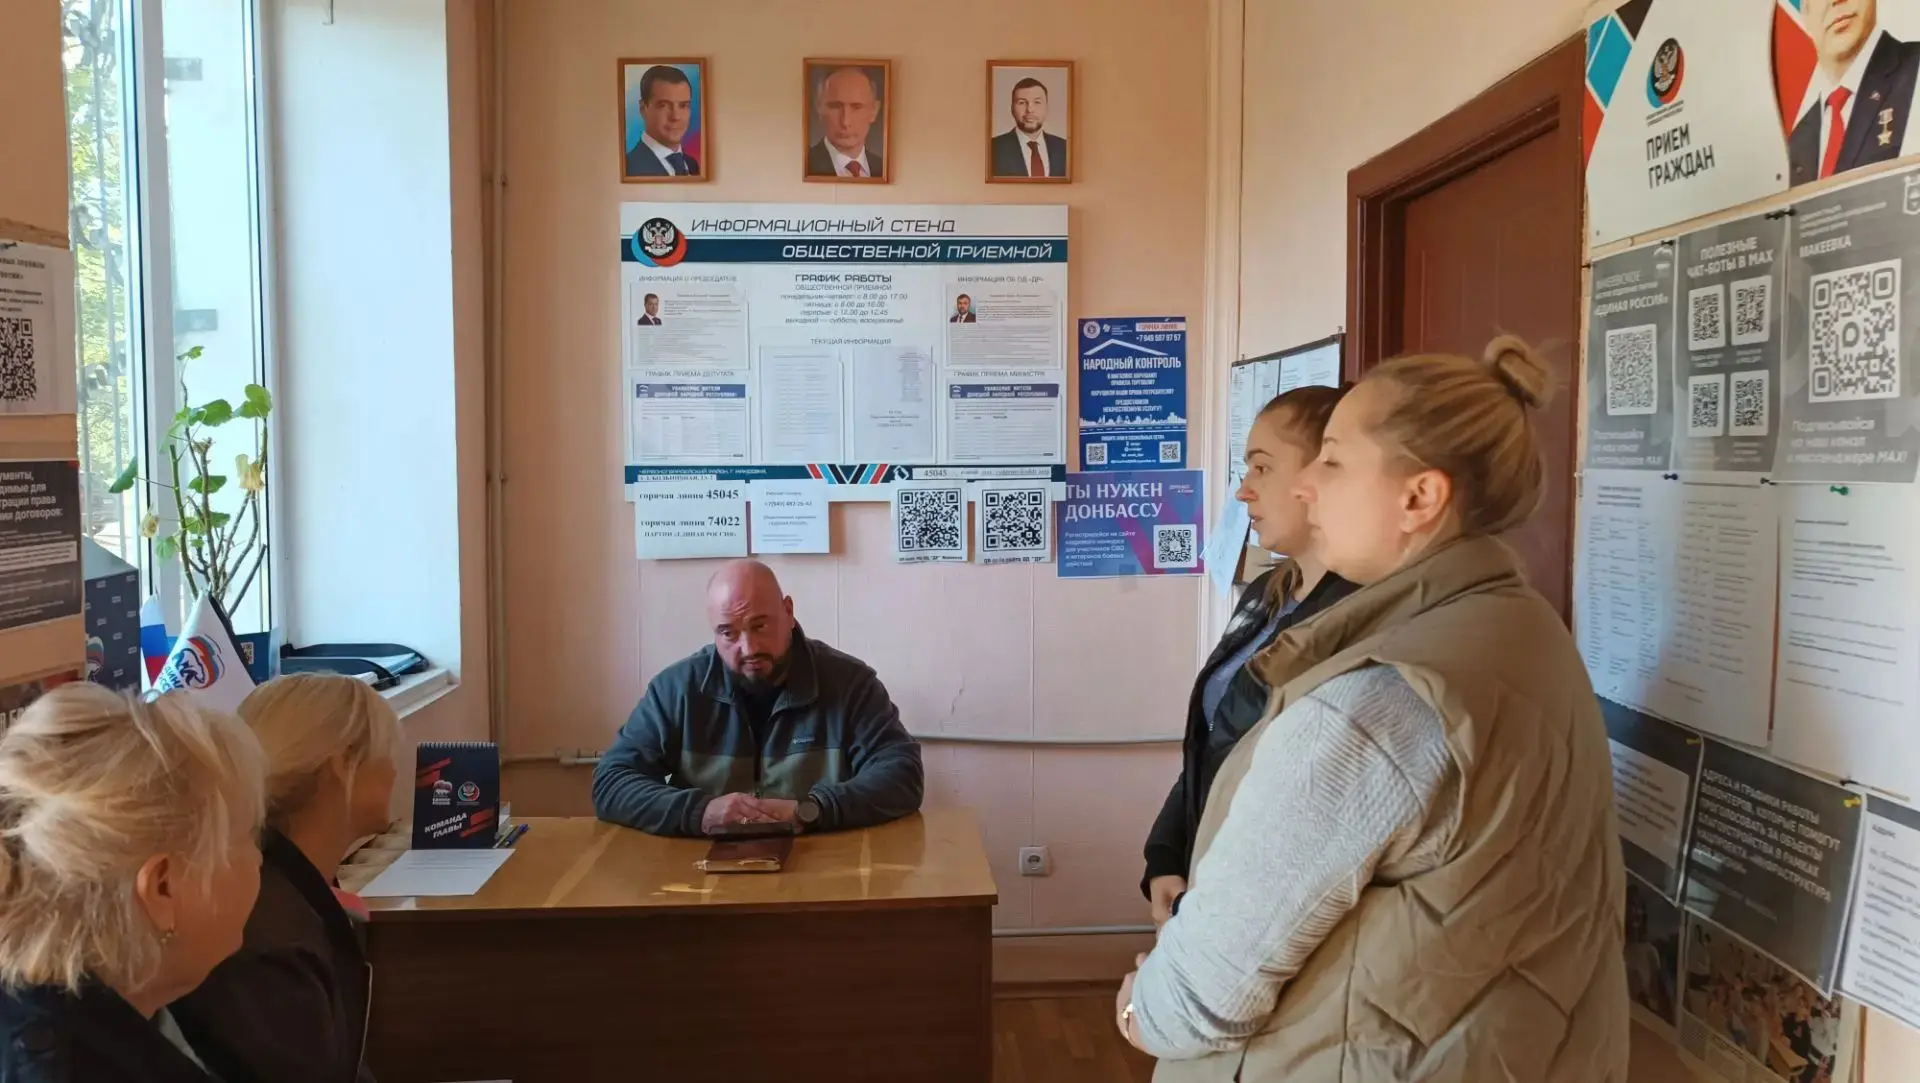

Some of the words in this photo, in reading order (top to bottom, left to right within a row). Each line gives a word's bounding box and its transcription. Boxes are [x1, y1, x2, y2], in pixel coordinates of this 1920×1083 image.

[1646, 123, 1690, 162] ПРИЕМ
[1648, 145, 1716, 189] ГРАЖДАН
[691, 216, 884, 233] ИНФОРМАЦИОННЫЙ
[890, 219, 956, 233] СТЕНД
[782, 242, 941, 259] ОБЩЕСТВЕННОЙ
[947, 242, 1053, 259] ПРИЕМНОЙ
[795, 274, 840, 282] ГРАФИК
[845, 274, 892, 282] РАБОТЫ
[1083, 356, 1133, 370] НАРОДНЫЙ
[1135, 357, 1182, 369] КОНТРОЛЬ
[0, 471, 34, 481] ументы,
[924, 469, 947, 477] 45045
[0, 485, 29, 495] димые
[640, 493, 674, 501] горячая
[706, 489, 739, 499] 45045
[1066, 484, 1090, 499] ТЫ
[1096, 482, 1163, 499] НУЖЕН
[1065, 502, 1163, 522] ДОНБАССУ
[641, 520, 676, 528] горячая
[707, 516, 740, 526] 74022
[424, 812, 468, 833] КОМАНДА
[432, 822, 462, 838] ГЛАВЫ
